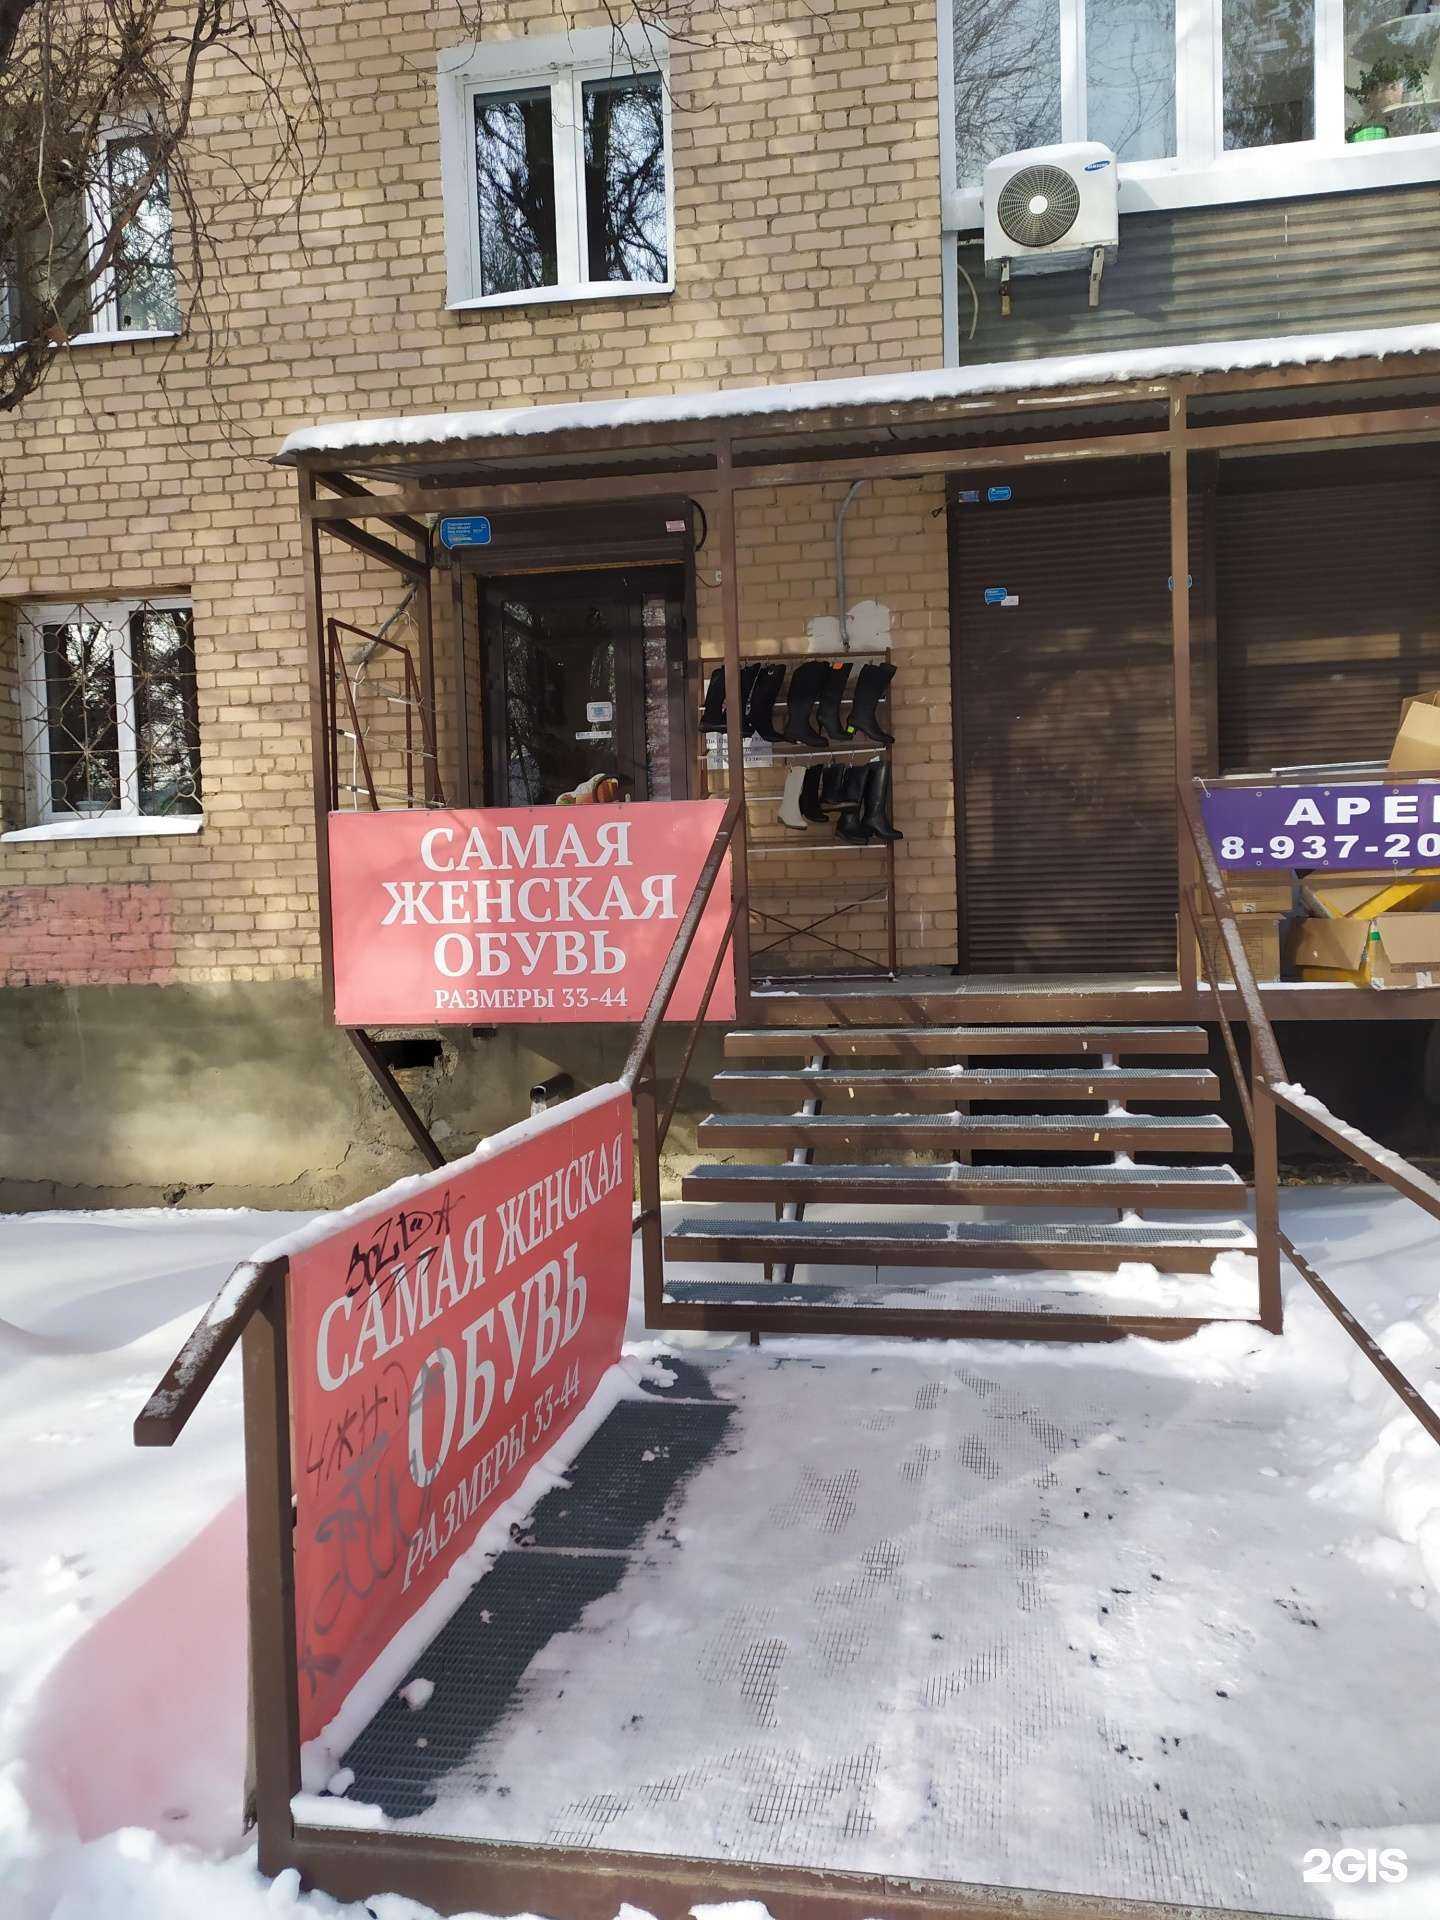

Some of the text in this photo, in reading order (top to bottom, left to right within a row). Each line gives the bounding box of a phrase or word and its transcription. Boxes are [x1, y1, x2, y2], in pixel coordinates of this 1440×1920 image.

[1284, 795, 1440, 826] АРЕ
[420, 821, 633, 873] САМАЯ
[380, 874, 679, 926] ЖЕНСКАЯ
[433, 930, 627, 977] ОБУВЬ
[433, 987, 629, 1010] РАЗМЕРЫ 33-44
[316, 1133, 623, 1392] САМАЯ ЖЕНСКАЯ
[409, 1241, 587, 1488] ОБУВЬ
[401, 1356, 581, 1594] РАЗМЕРЫ 33-44
